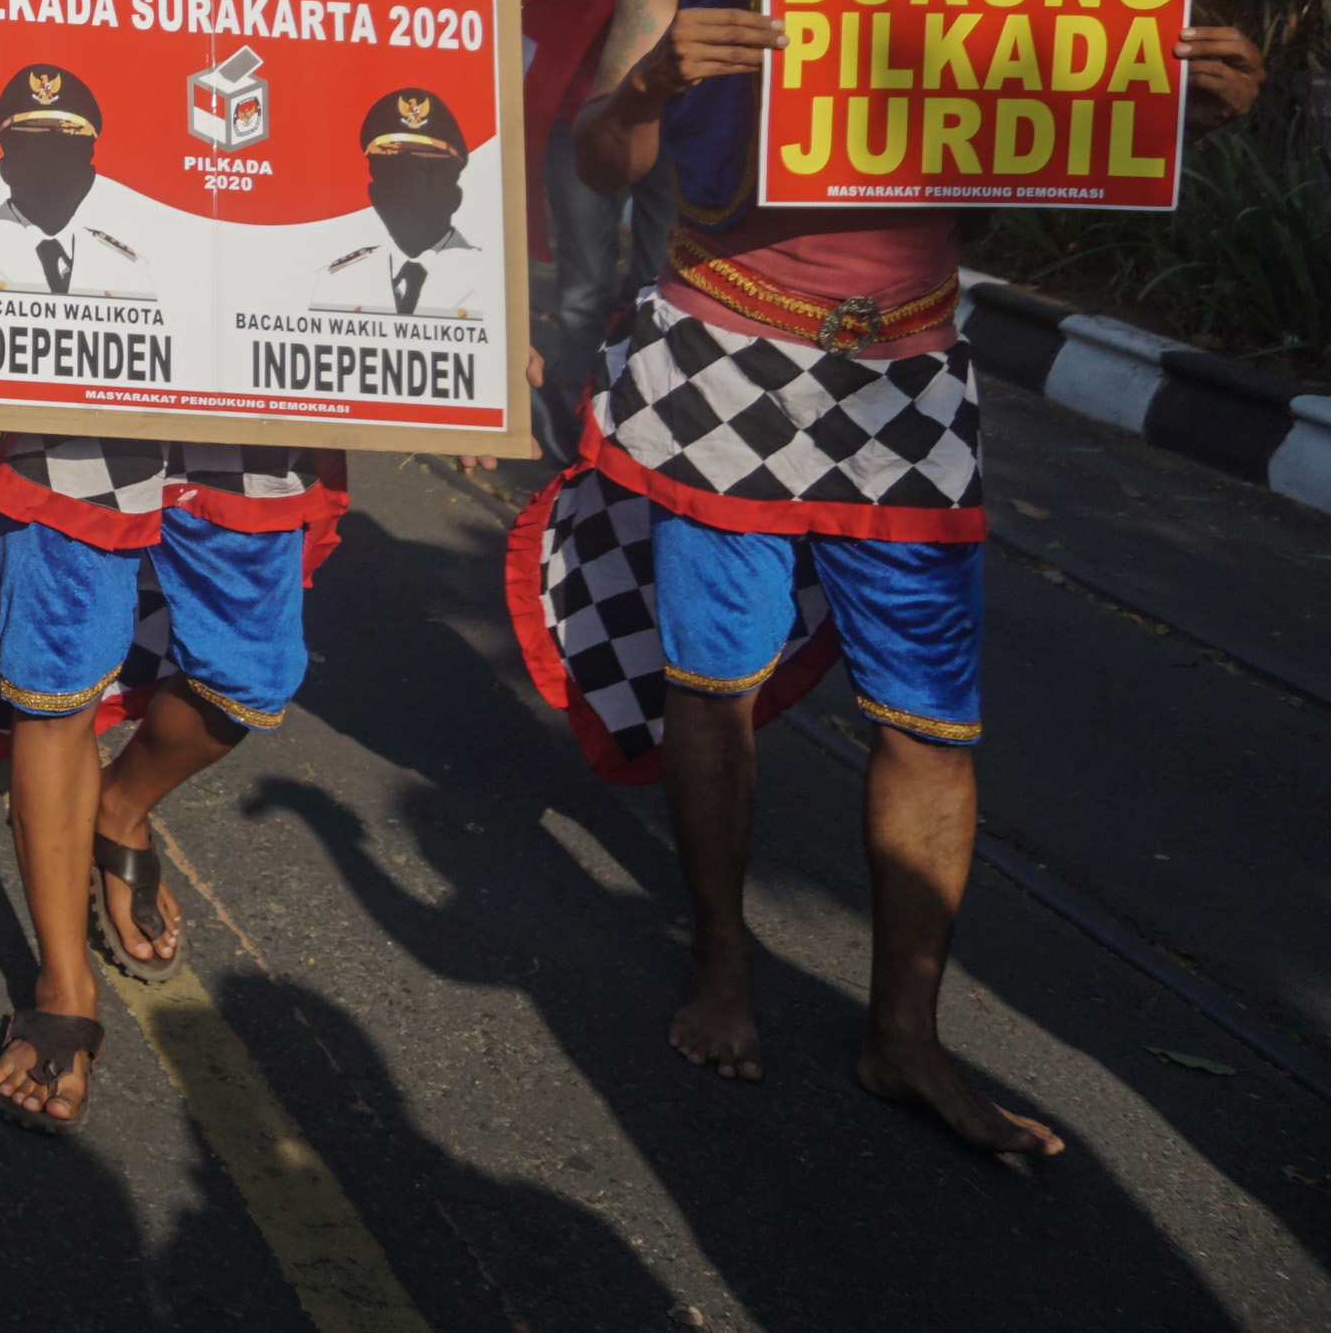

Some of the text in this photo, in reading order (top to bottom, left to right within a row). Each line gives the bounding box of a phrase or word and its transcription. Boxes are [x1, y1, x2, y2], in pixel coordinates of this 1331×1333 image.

[388, 5, 484, 52] 2020
[781, 11, 1172, 94] PILKADA
[780, 96, 1166, 179] JURDIL
[183, 156, 274, 176] PILKADA
[204, 174, 253, 192] 2020
[827, 186, 1104, 199] MASYARAKAT PENDUKUNG DEMOKRASI
[63, 303, 165, 326] WALIKOTA
[235, 312, 489, 345] BACALON WAKIL WALIKOTA
[251, 340, 476, 401] INDEPENDEN
[85, 391, 351, 414] MASYARAKAT PENDUKUNG DEMOKRASI
